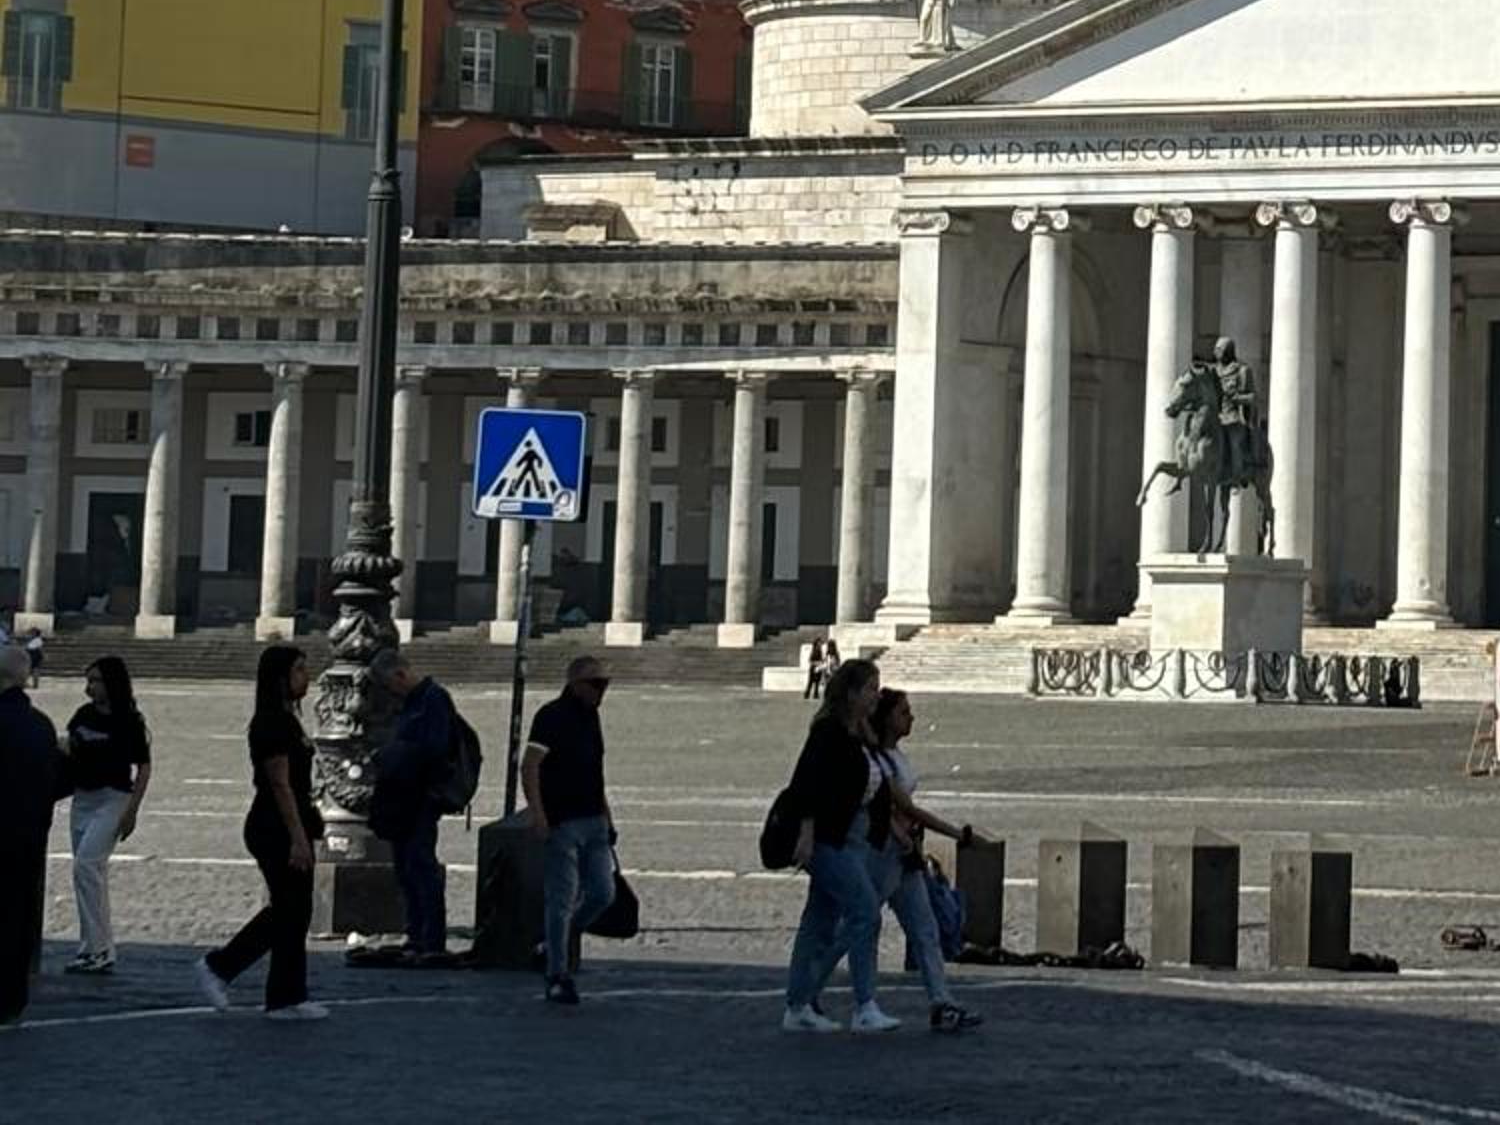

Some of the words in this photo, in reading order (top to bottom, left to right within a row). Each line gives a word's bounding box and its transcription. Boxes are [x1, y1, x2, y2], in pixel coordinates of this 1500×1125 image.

[1033, 138, 1178, 164] FRANCISCO
[1188, 137, 1219, 160] DE
[1321, 130, 1500, 158] FERDINANDVS
